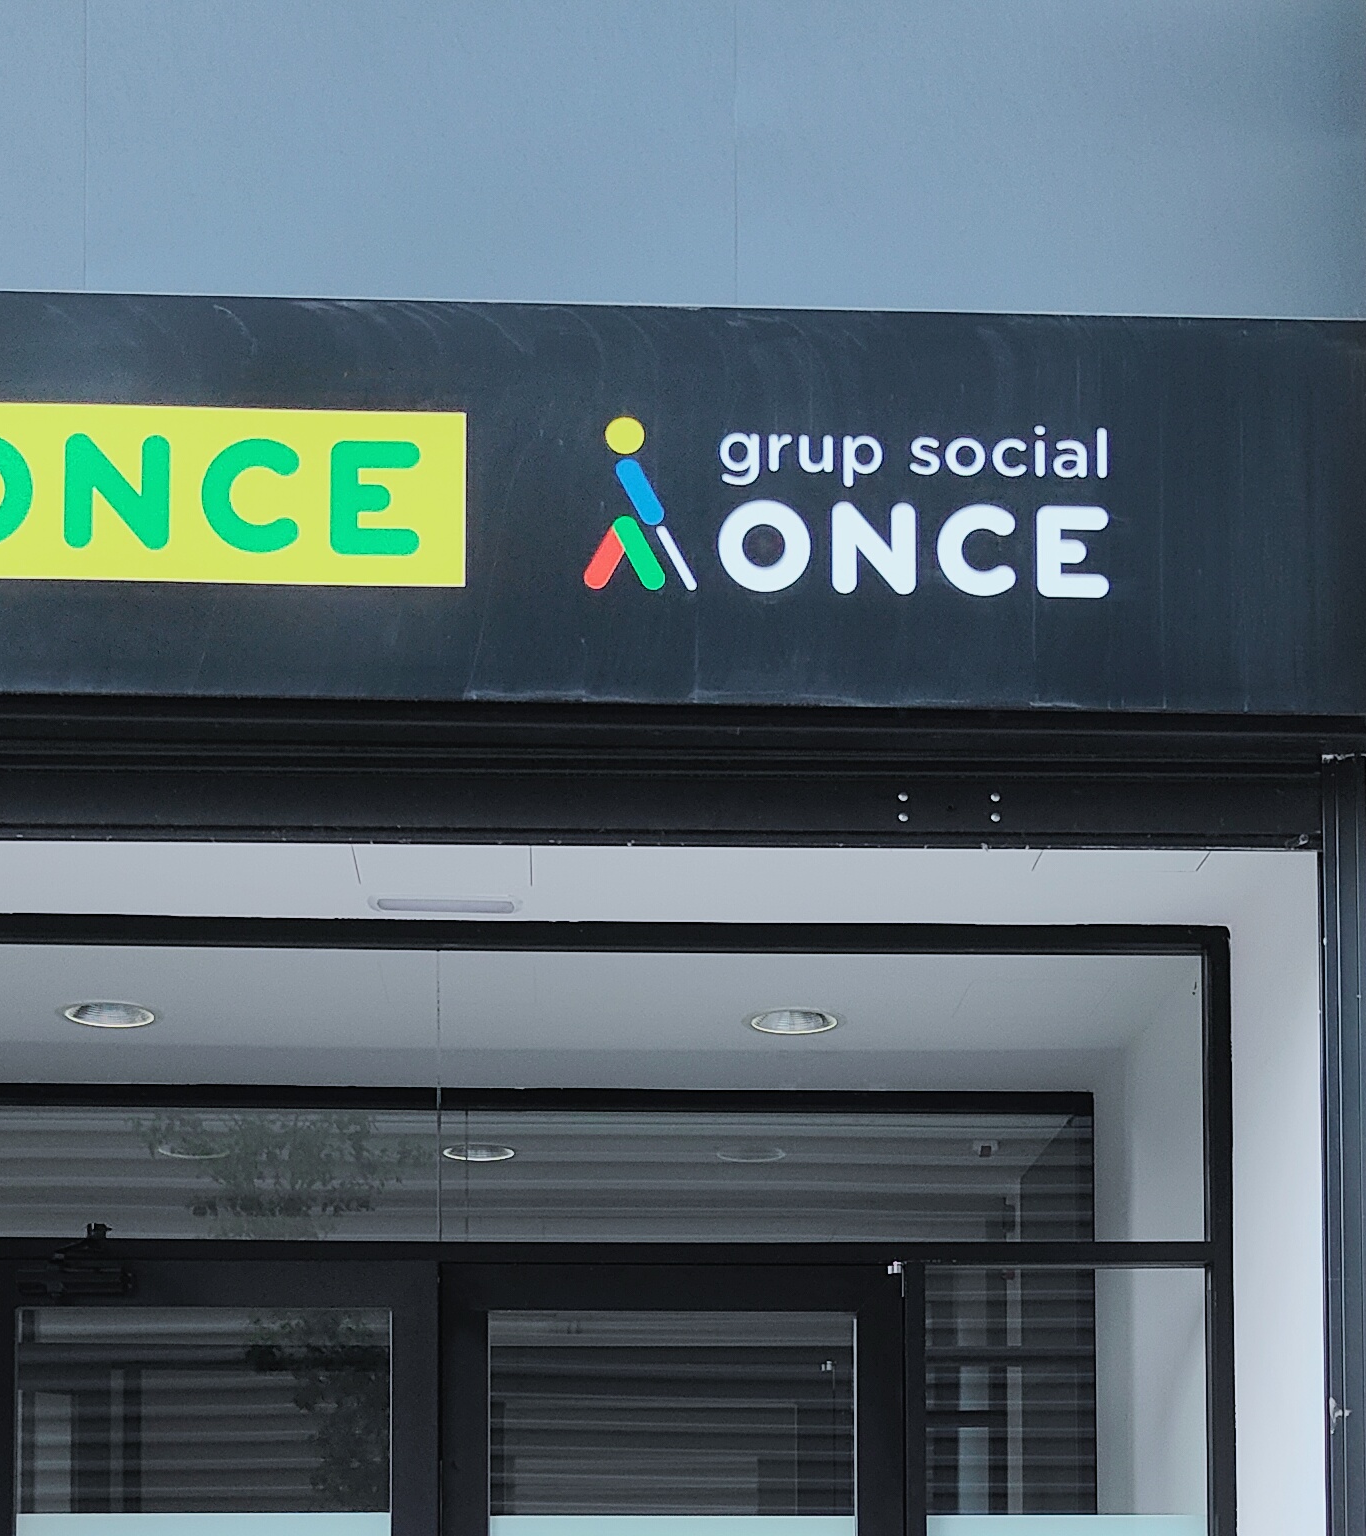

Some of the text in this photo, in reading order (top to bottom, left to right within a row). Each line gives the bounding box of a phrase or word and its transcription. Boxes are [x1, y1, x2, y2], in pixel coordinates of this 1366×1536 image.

[719, 425, 1109, 488] grup social
[717, 499, 1110, 598] ONCE
